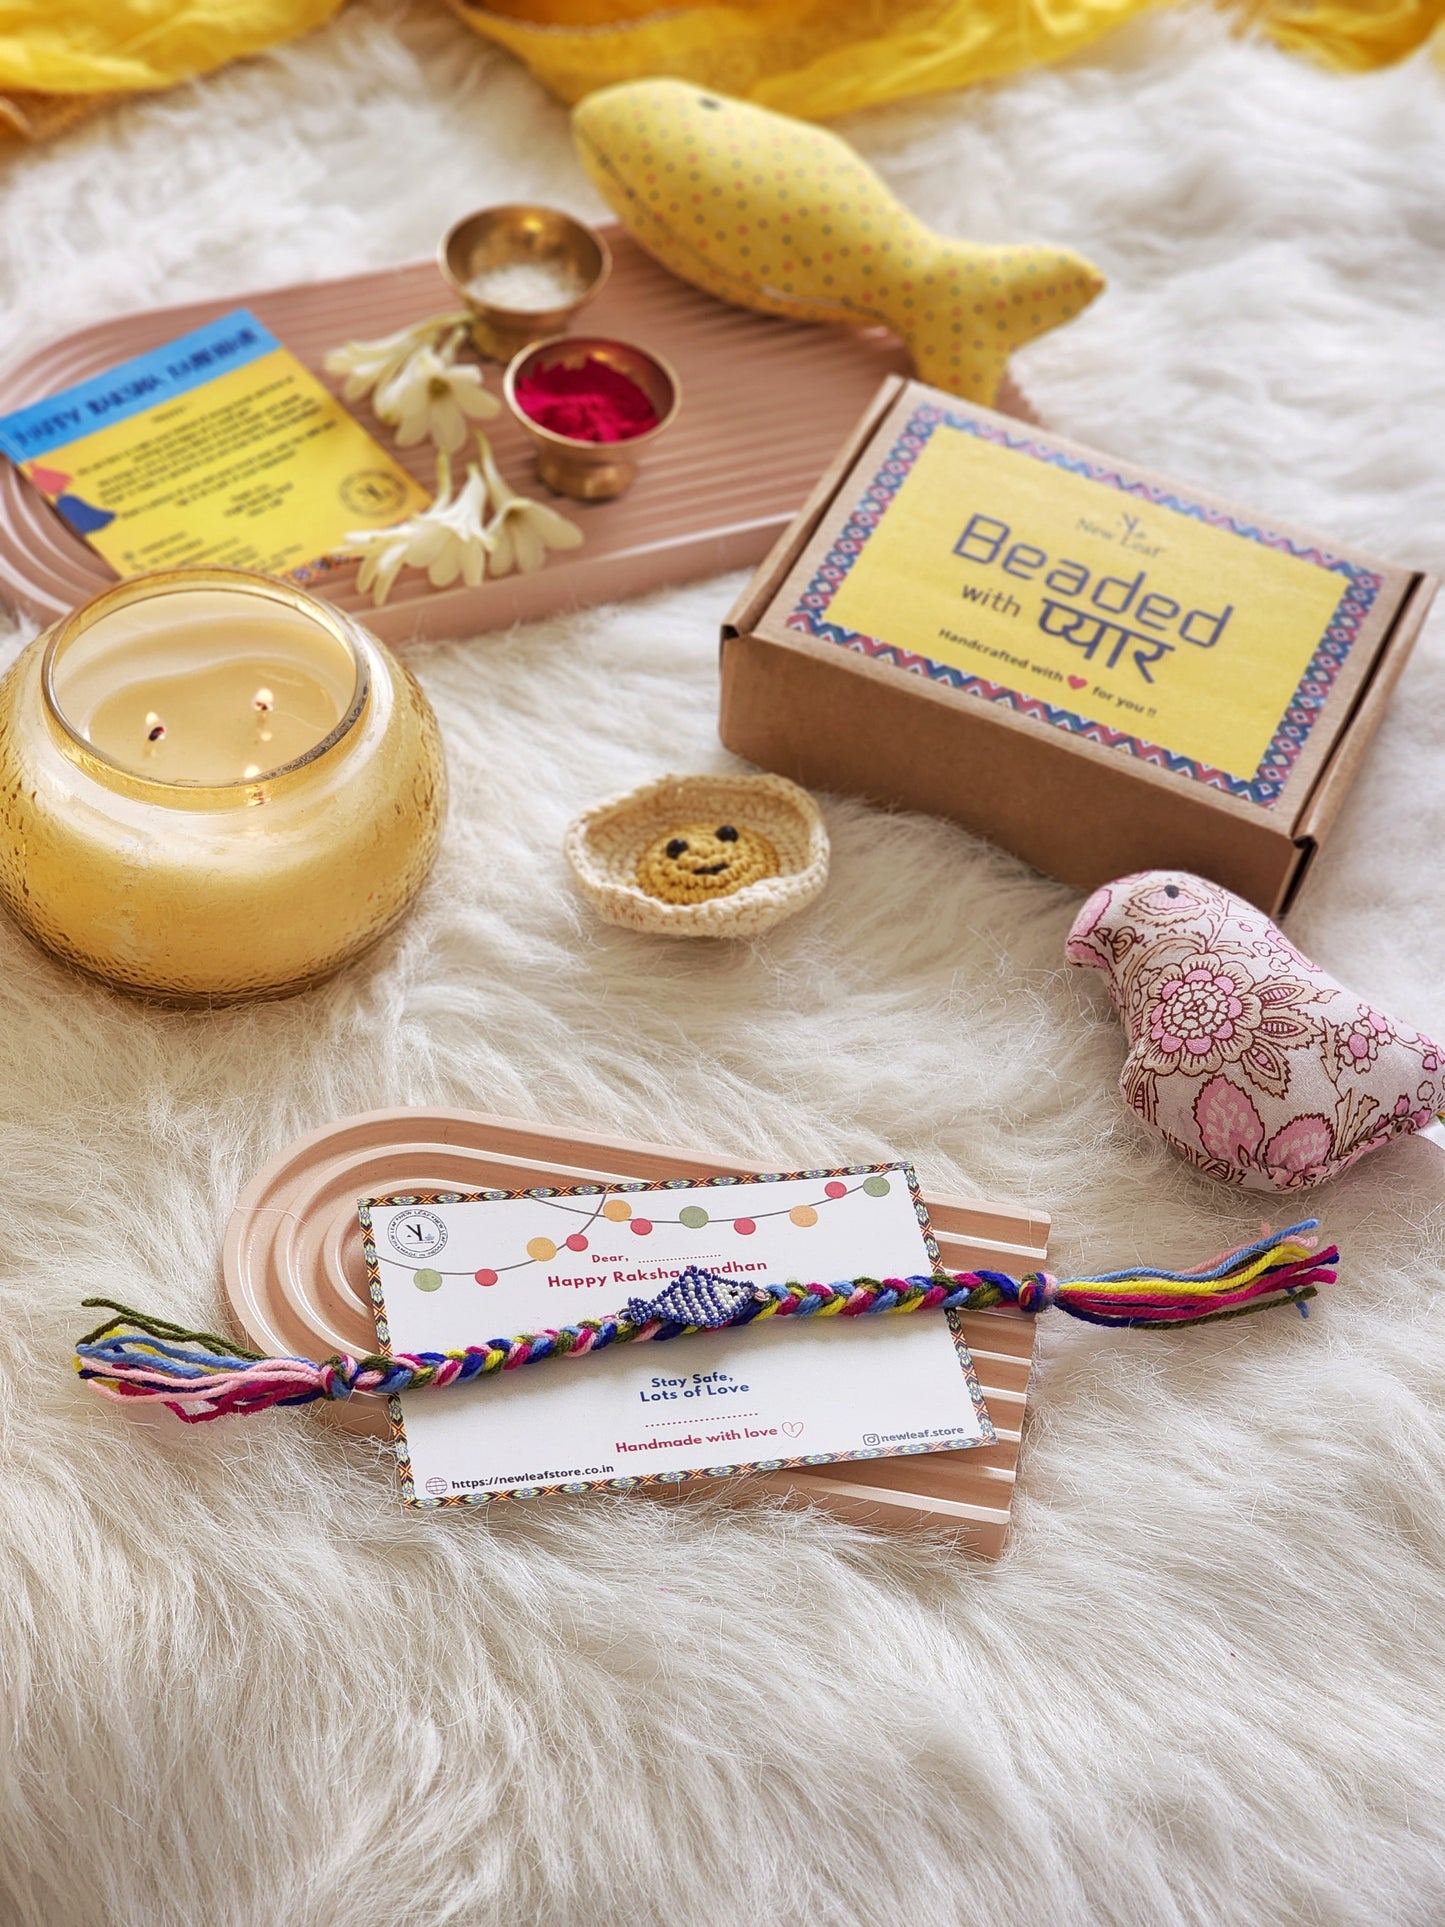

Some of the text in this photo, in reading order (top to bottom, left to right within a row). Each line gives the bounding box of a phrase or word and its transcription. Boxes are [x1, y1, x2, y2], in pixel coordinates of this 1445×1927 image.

[952, 513, 1235, 649] Beaded
[962, 584, 1022, 618] with
[1038, 597, 1176, 684] प्यार
[938, 628, 1029, 670] Handcrafted
[1031, 664, 1064, 683] with
[1092, 686, 1114, 702] for
[1117, 697, 1145, 714] you
[591, 1253, 629, 1264] Dear,
[548, 1274, 607, 1289] Happy
[612, 1269, 681, 1283] Raksha
[640, 1383, 750, 1403] Lots of Love
[651, 1372, 734, 1389] Stay Safe,
[615, 1427, 778, 1453] Handmade with love
[880, 1426, 965, 1443] newleaf.store
[451, 1464, 615, 1490] https://newleafstore.co.in
